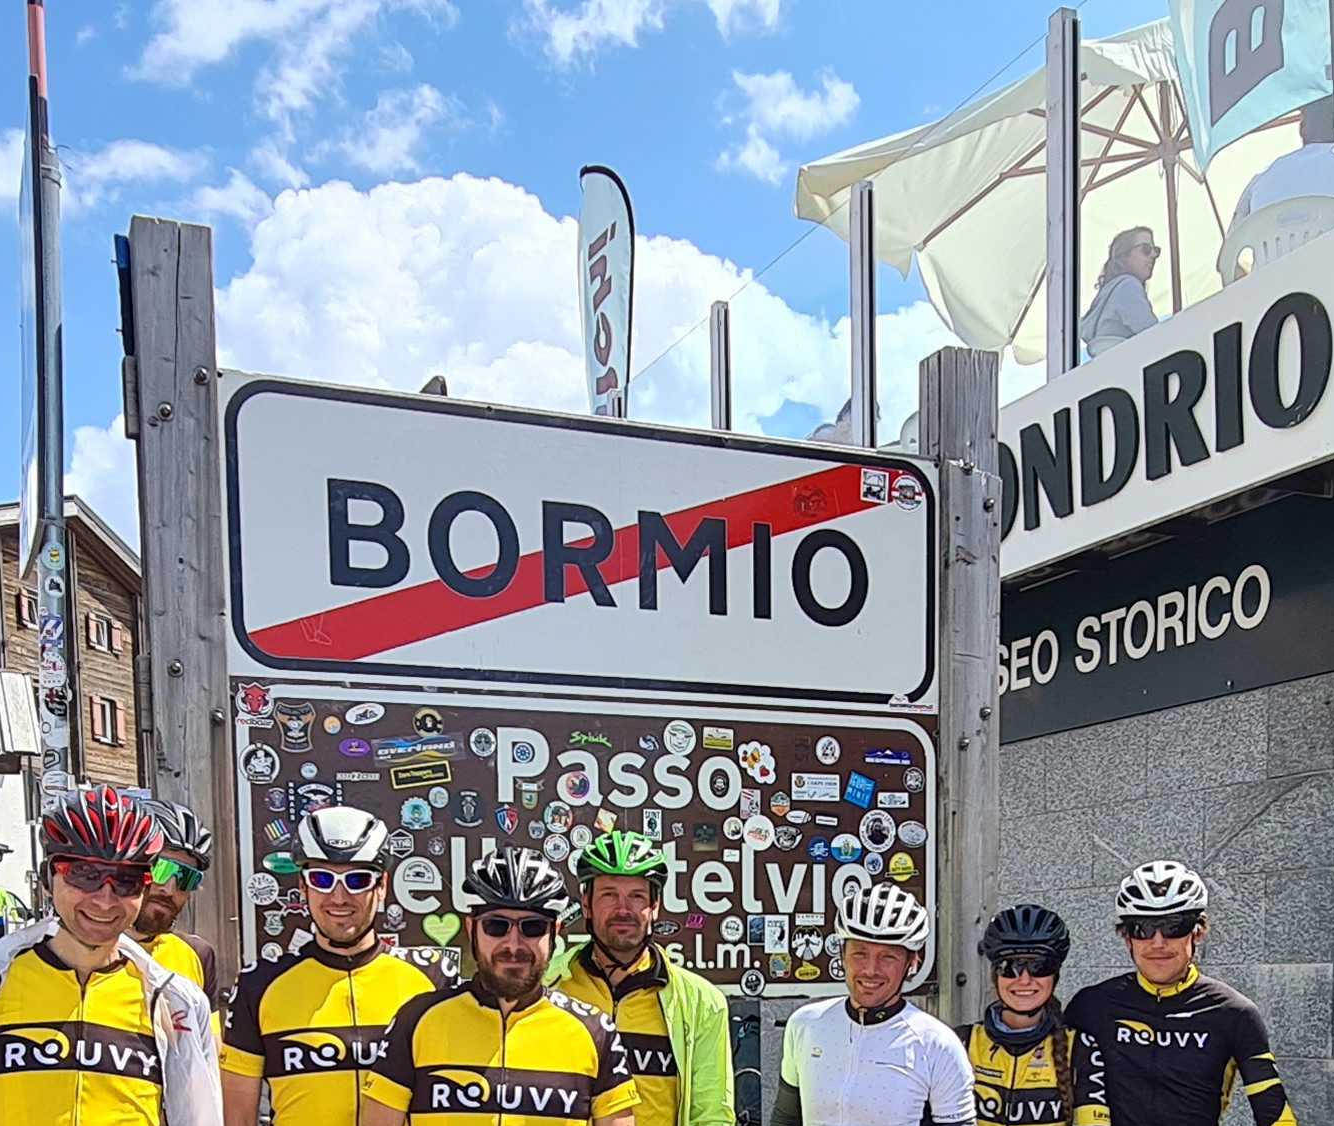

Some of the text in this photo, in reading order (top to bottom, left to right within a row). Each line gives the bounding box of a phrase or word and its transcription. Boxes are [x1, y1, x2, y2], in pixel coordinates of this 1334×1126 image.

[326, 477, 868, 628] BORMIO
[1075, 564, 1271, 674] STORICO
[496, 726, 742, 811] Passo
[662, 840, 873, 914] telvio
[4, 1035, 158, 1077] ROUVY
[1117, 1024, 1209, 1048] ROUVY
[432, 1078, 578, 1115] ROUVY
